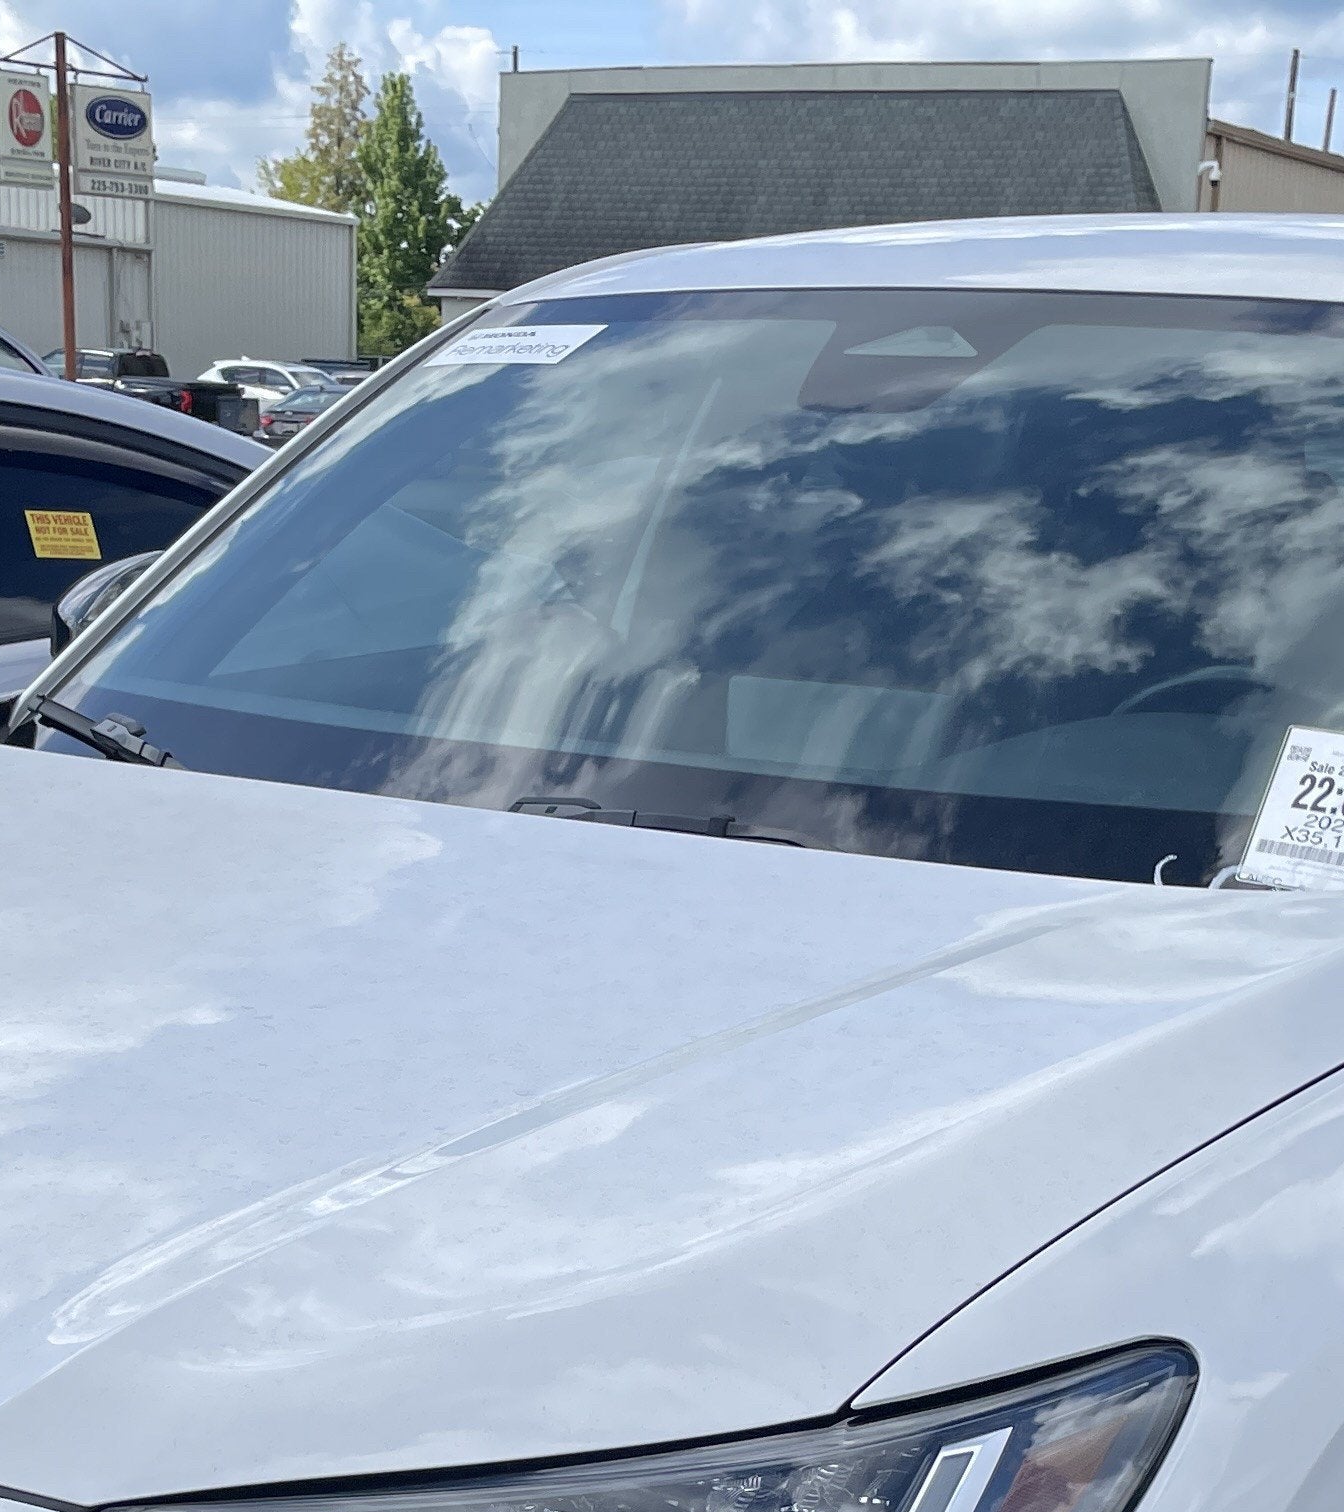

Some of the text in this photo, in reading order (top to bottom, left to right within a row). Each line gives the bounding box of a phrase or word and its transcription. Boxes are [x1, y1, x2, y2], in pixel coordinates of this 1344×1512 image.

[94, 104, 142, 127] Carrier
[115, 159, 131, 169] CITY
[29, 513, 90, 527] THIS VEHICLE
[35, 526, 51, 535] NOT
[70, 527, 90, 537] SALE
[1309, 761, 1336, 774] Sale
